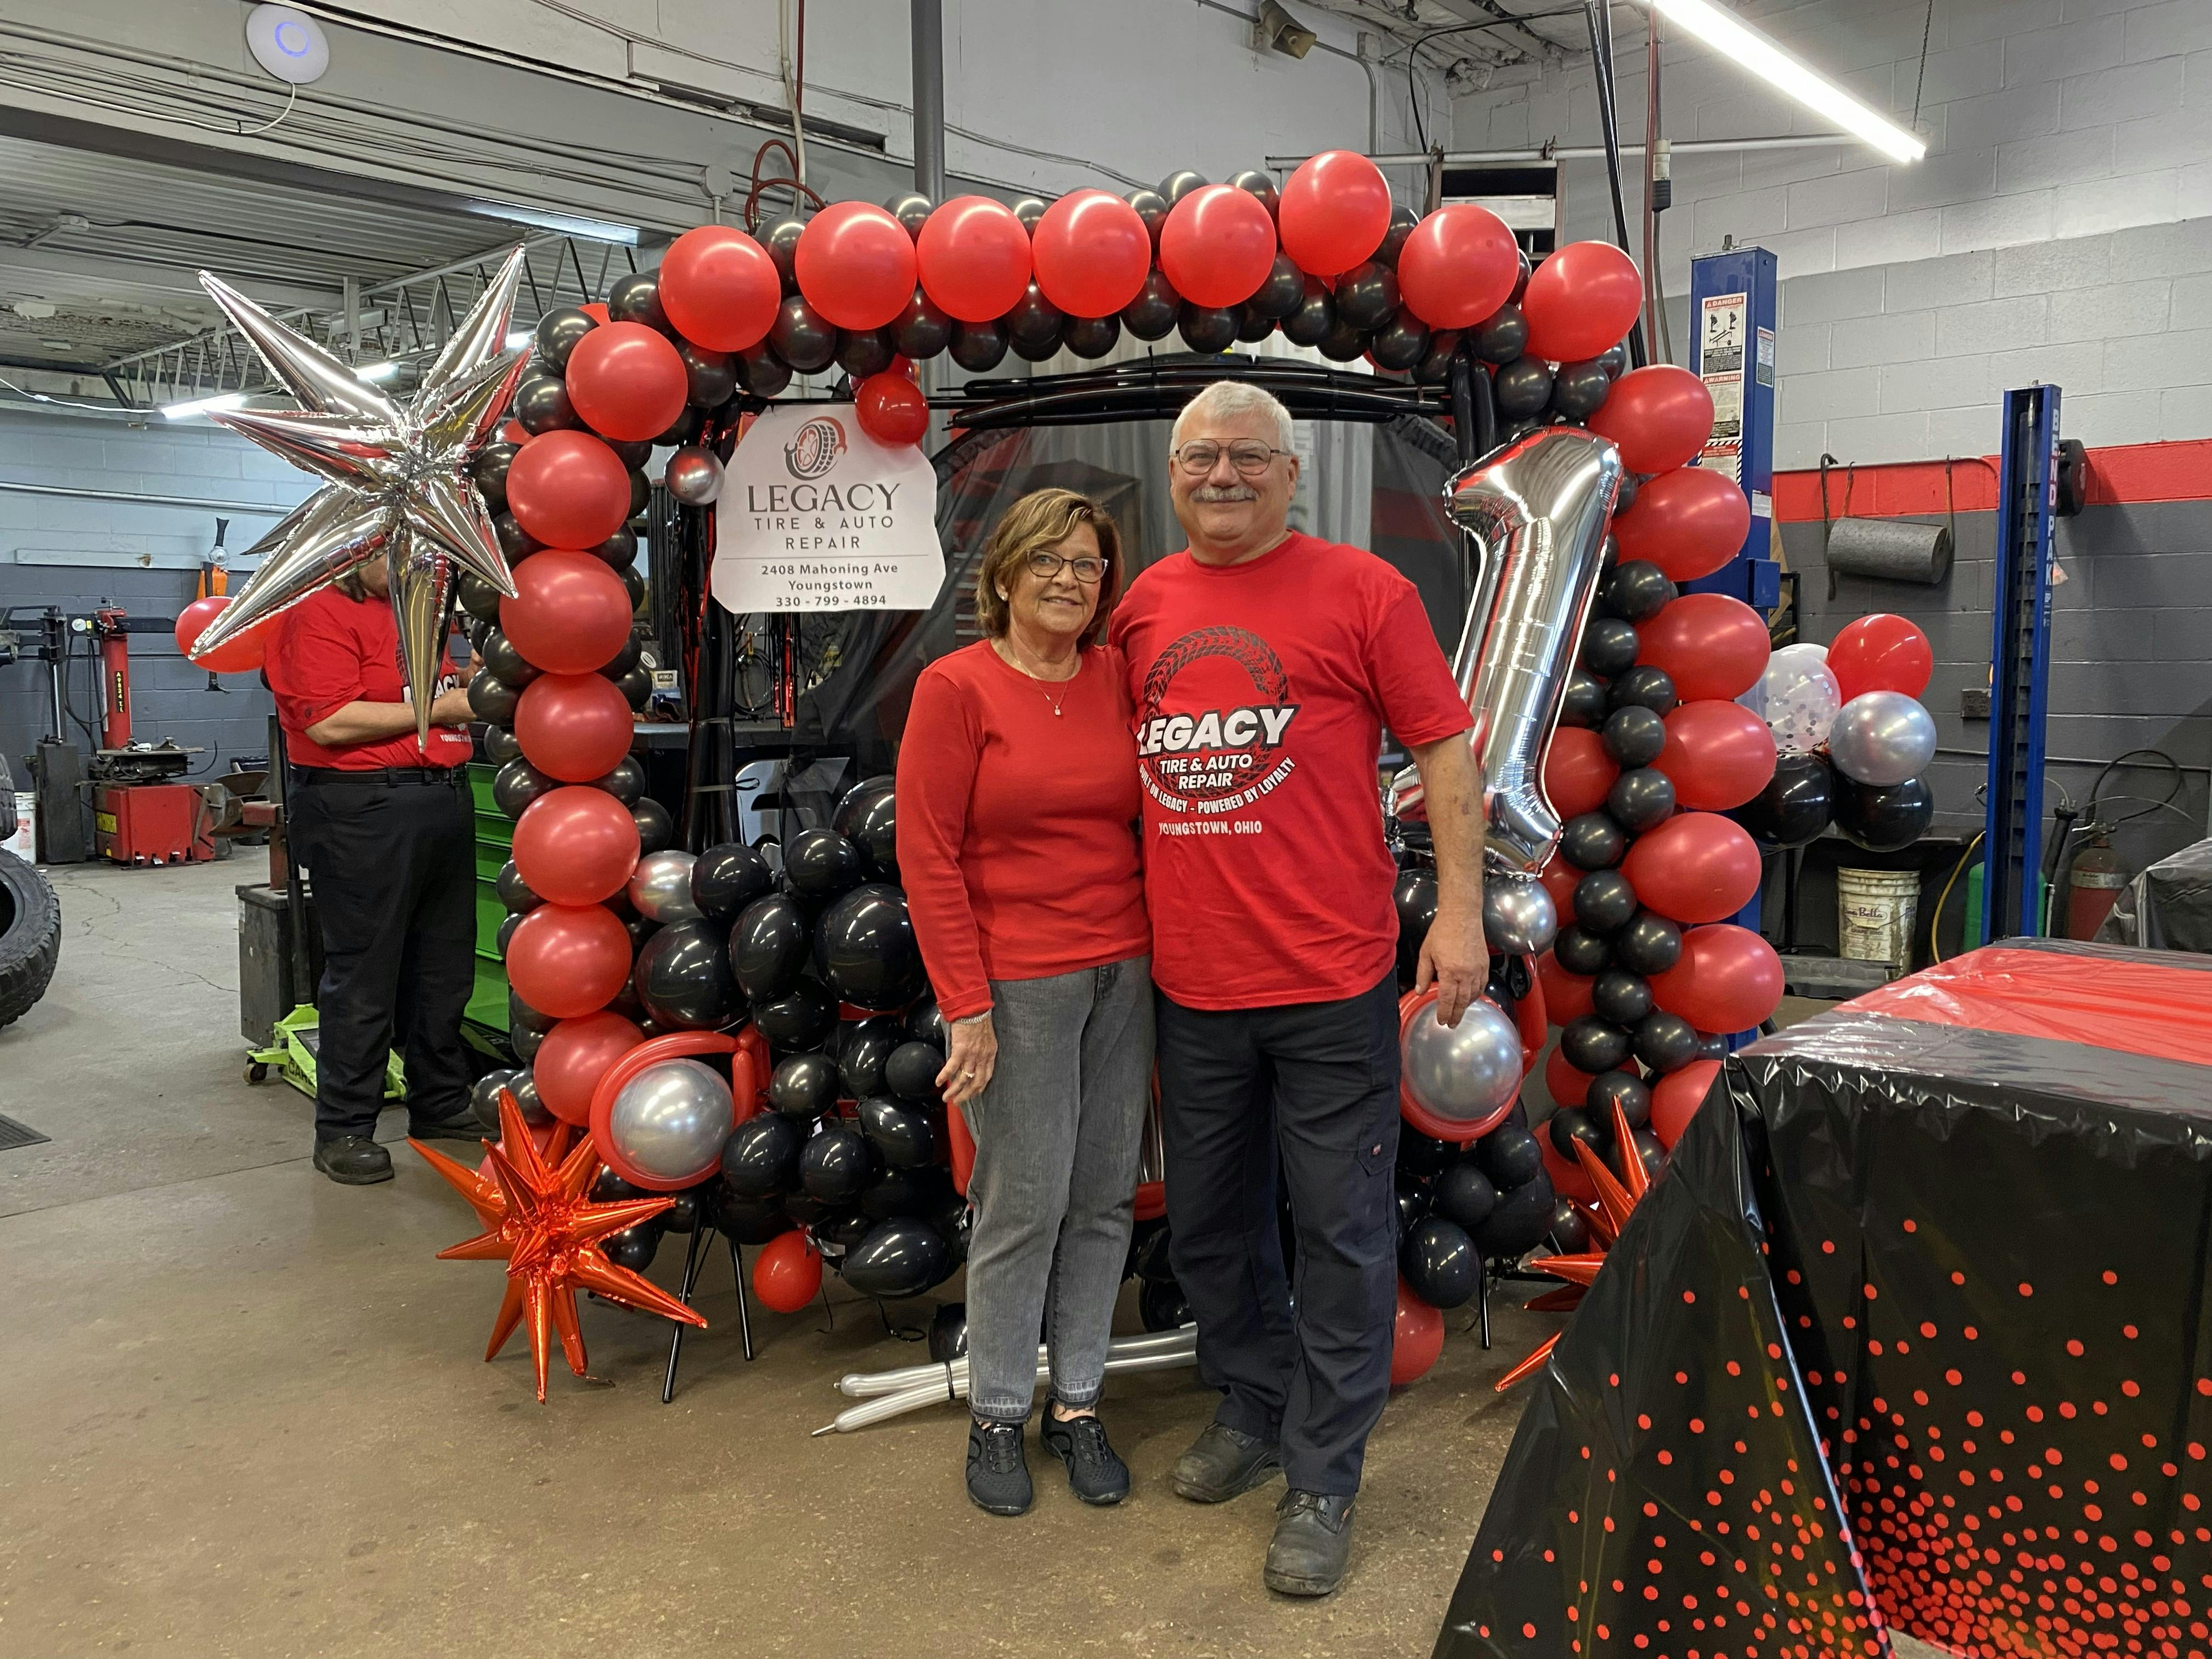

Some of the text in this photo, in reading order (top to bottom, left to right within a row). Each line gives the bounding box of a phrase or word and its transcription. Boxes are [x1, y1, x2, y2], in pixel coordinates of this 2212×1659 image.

[1713, 297, 1742, 306] DANGER
[1708, 374, 1740, 383] WARNING
[2049, 408, 2059, 506] BEND
[748, 483, 900, 513] LEGACY
[755, 516, 894, 530] TIRE & AUTO
[786, 536, 860, 549] REPAIR
[2046, 515, 2055, 585] PAK
[761, 563, 898, 576] 2408 Mahoning Ave
[788, 580, 872, 592] Youngstown
[776, 597, 800, 606] 330
[815, 596, 839, 606] 799
[854, 596, 886, 605] 4894
[1137, 709, 1294, 756] LEGACY
[1160, 754, 1252, 774] TIRE & AUTO
[1139, 763, 1152, 788] BUILT
[1150, 783, 1159, 799] ON
[1159, 791, 1188, 812] LEGACY
[1198, 794, 1244, 814] POWERED
[1243, 786, 1259, 803] BY
[1257, 757, 1295, 795] LOYALTY
[1179, 772, 1233, 789] REPAIR
[1159, 821, 1262, 835] YOUNGSTOWN, OHIO
[1859, 907, 1883, 917] Bella
